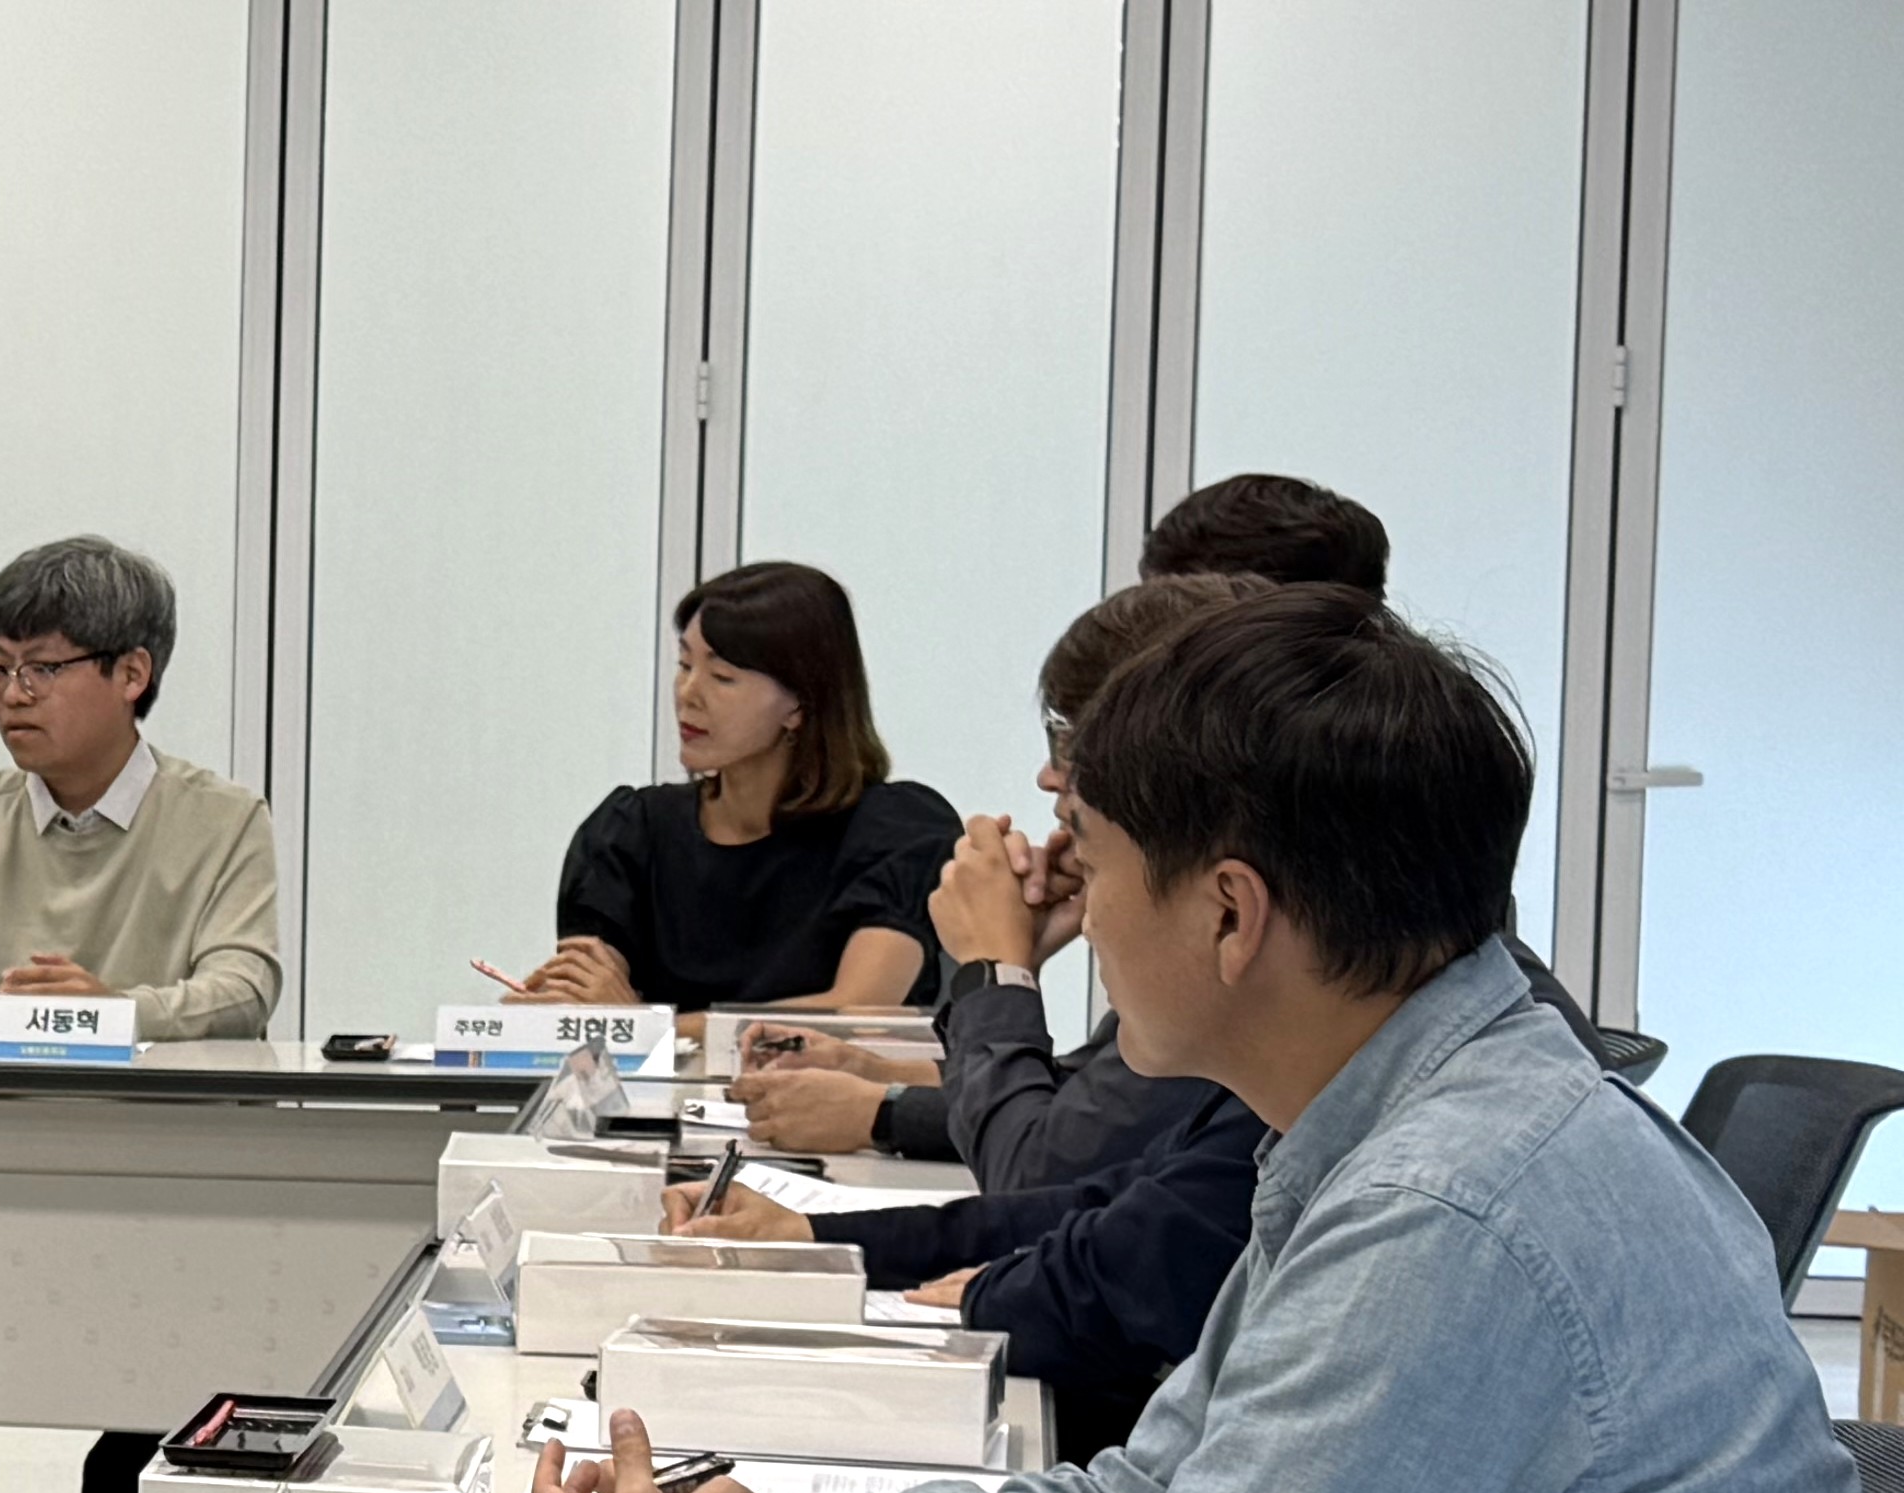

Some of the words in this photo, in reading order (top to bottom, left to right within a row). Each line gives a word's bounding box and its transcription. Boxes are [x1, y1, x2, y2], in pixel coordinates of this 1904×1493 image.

[25, 1008, 98, 1035] 서동혁
[454, 1019, 503, 1036] 주무관
[556, 1016, 634, 1043] 최현정
